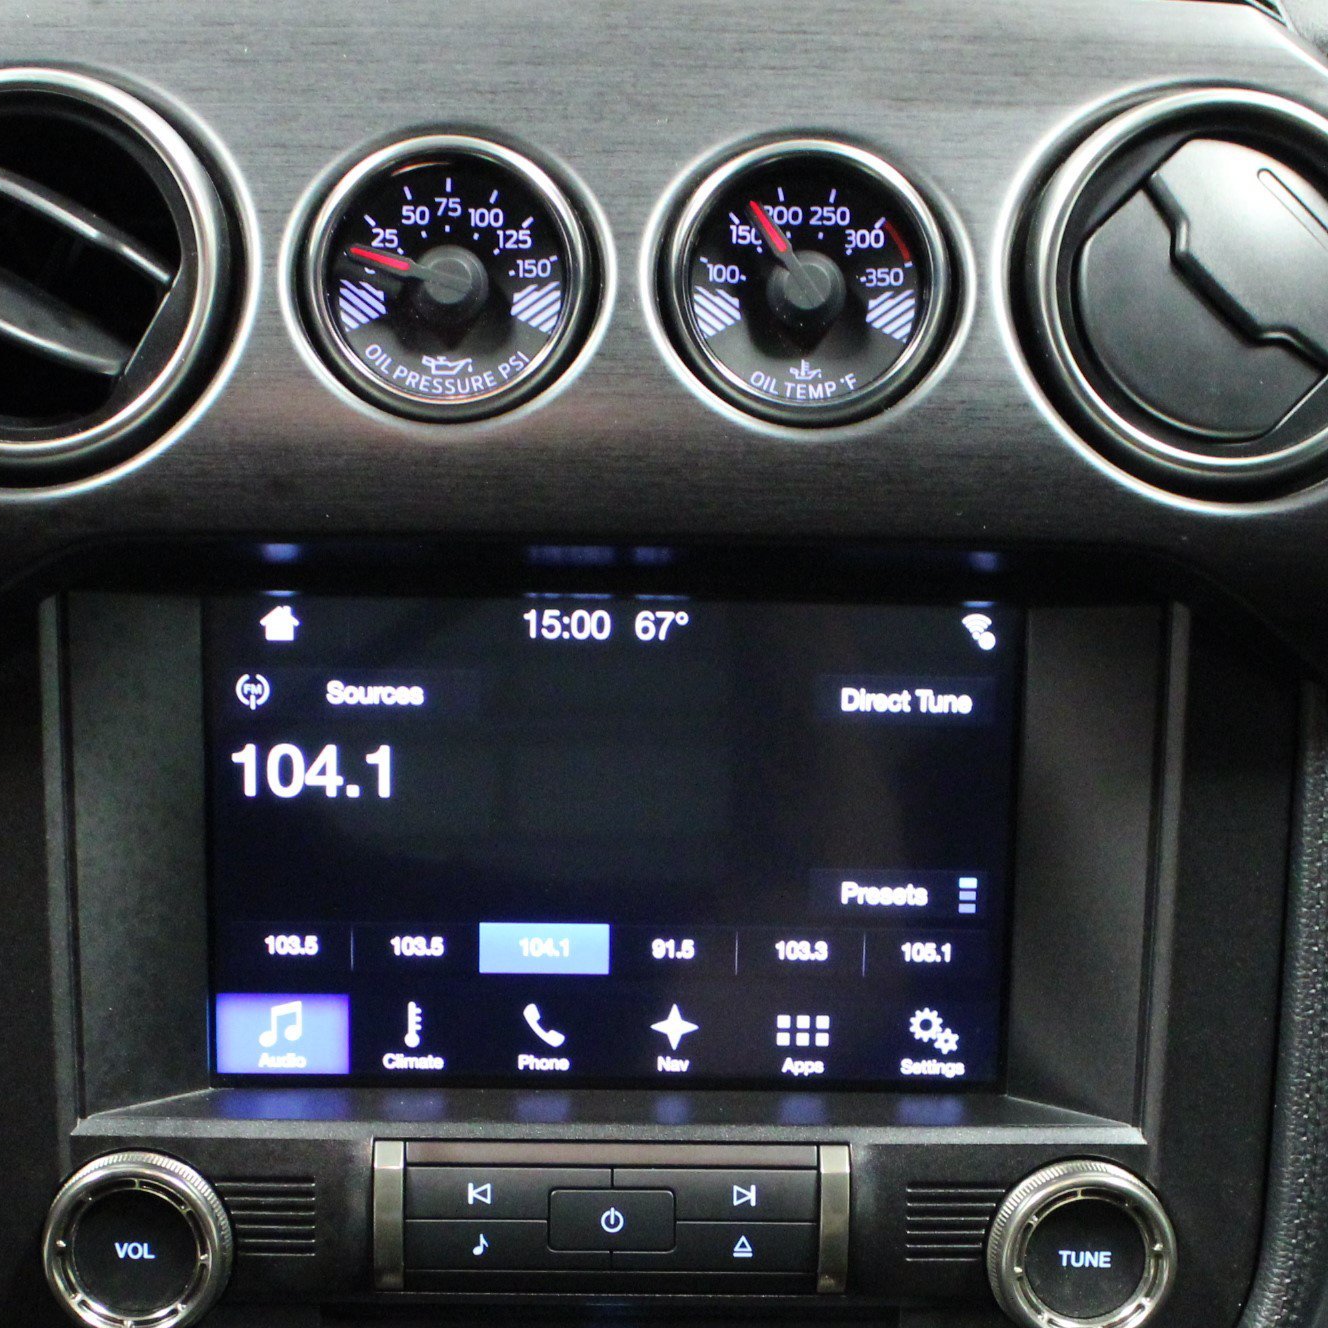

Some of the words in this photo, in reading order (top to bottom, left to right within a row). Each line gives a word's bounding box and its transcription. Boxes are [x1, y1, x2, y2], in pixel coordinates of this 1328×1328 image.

[401, 205, 430, 225] 50
[434, 197, 462, 217] 75
[809, 206, 851, 226] 250
[469, 208, 503, 228] 100
[371, 229, 398, 248] 25
[497, 229, 531, 249] 125
[844, 229, 885, 249] 300
[516, 259, 551, 278] 150
[706, 263, 739, 283] 100
[865, 267, 904, 287] 350
[364, 343, 389, 375] OIL
[393, 367, 496, 395] PRESSURE
[501, 351, 531, 380] PSI
[750, 371, 778, 396] OIL
[784, 381, 837, 400] TEMP
[523, 608, 611, 640] 15:00
[633, 610, 689, 641] 67°
[326, 679, 425, 706] Sources
[840, 687, 911, 713] Direct
[915, 689, 973, 715] Tune
[231, 742, 392, 799] 104.1
[840, 881, 929, 907] Presets
[264, 934, 319, 957] 103.5
[390, 936, 445, 958] 103.5
[518, 938, 570, 959] 104.1
[651, 938, 696, 960] 91.5
[901, 942, 952, 963] 105.1
[258, 1052, 307, 1070] Audio
[382, 1052, 445, 1071] Climate
[517, 1053, 570, 1072] Phone
[656, 1055, 690, 1073] Nav
[782, 1057, 825, 1077] Apps
[900, 1058, 966, 1079] Settings
[114, 1240, 156, 1261] VOL
[1058, 1249, 1112, 1269] TUNE
